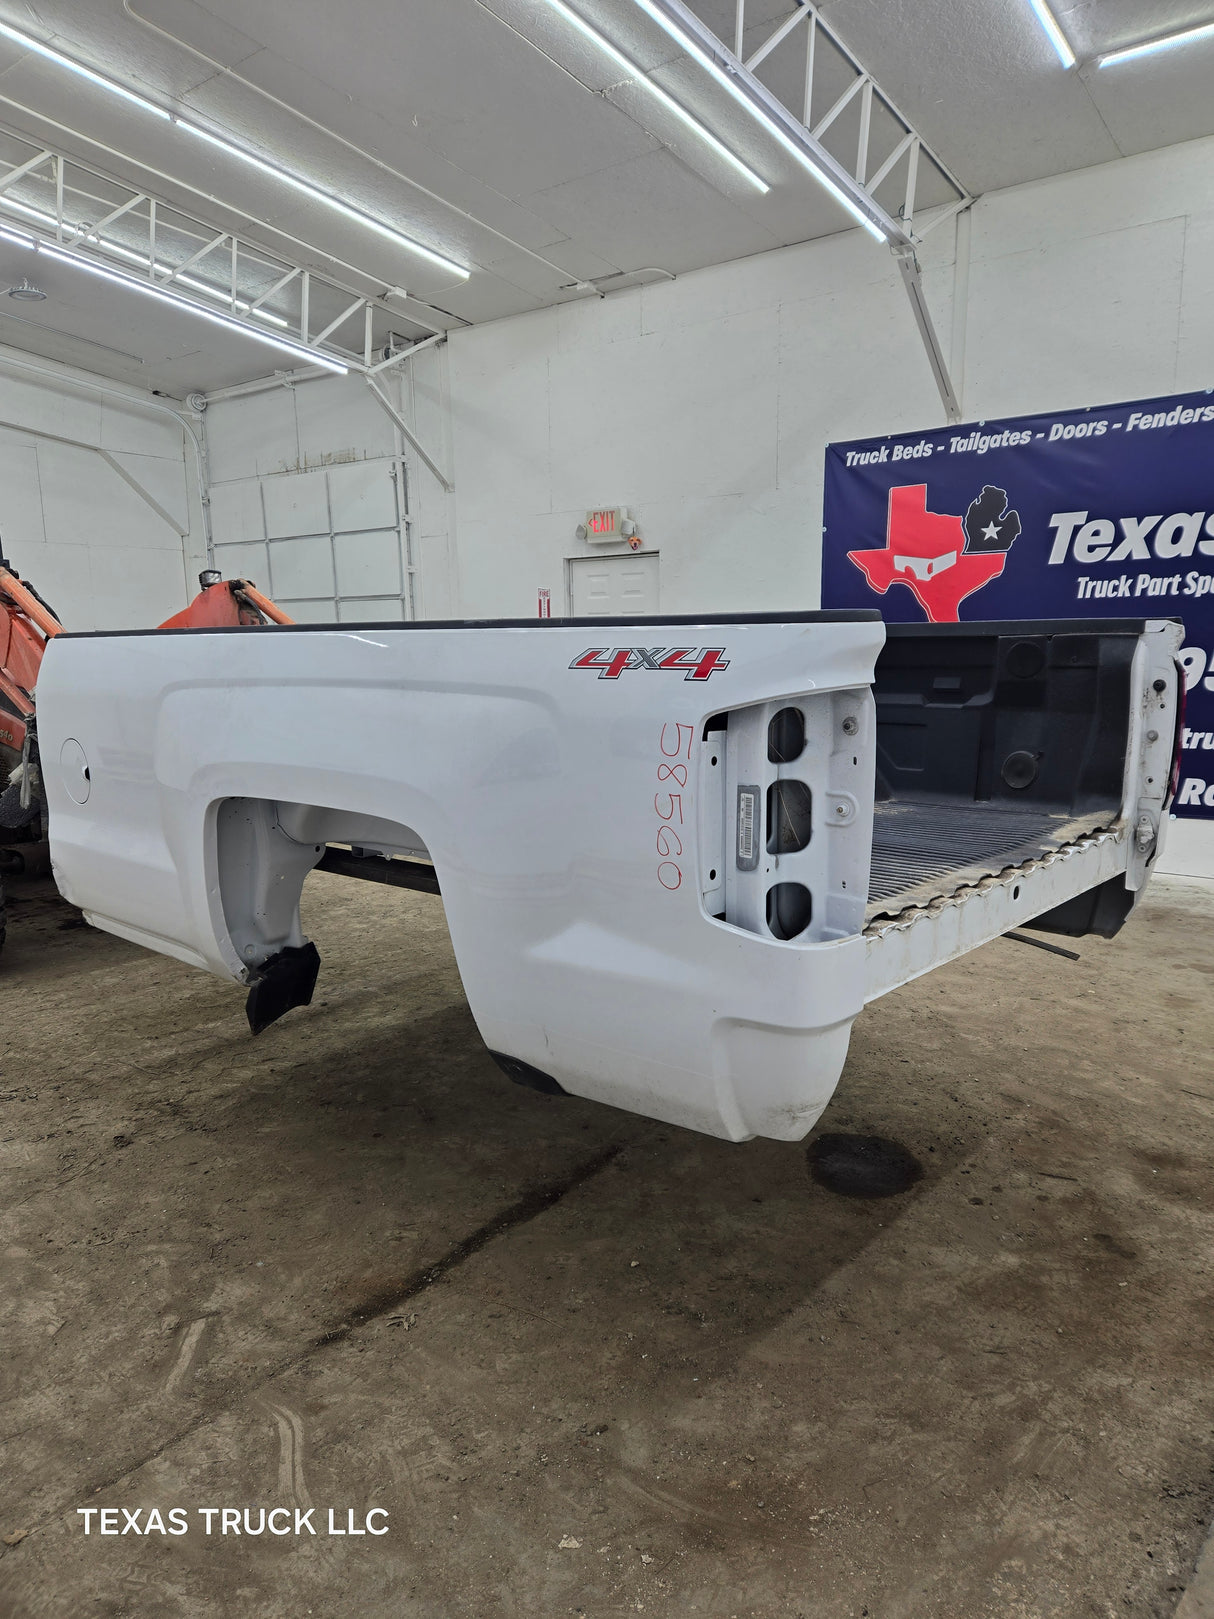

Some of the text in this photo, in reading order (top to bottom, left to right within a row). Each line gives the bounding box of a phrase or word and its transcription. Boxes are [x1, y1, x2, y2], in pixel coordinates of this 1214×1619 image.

[846, 446, 890, 467] Truck
[892, 440, 934, 461] Beds
[950, 429, 1032, 454] Tailgates
[1048, 420, 1108, 441] Doors
[1126, 405, 1214, 432] Fenders
[592, 510, 615, 533] EXIT
[1077, 571, 1214, 599] Truck Part Sp
[655, 722, 694, 891] 58560
